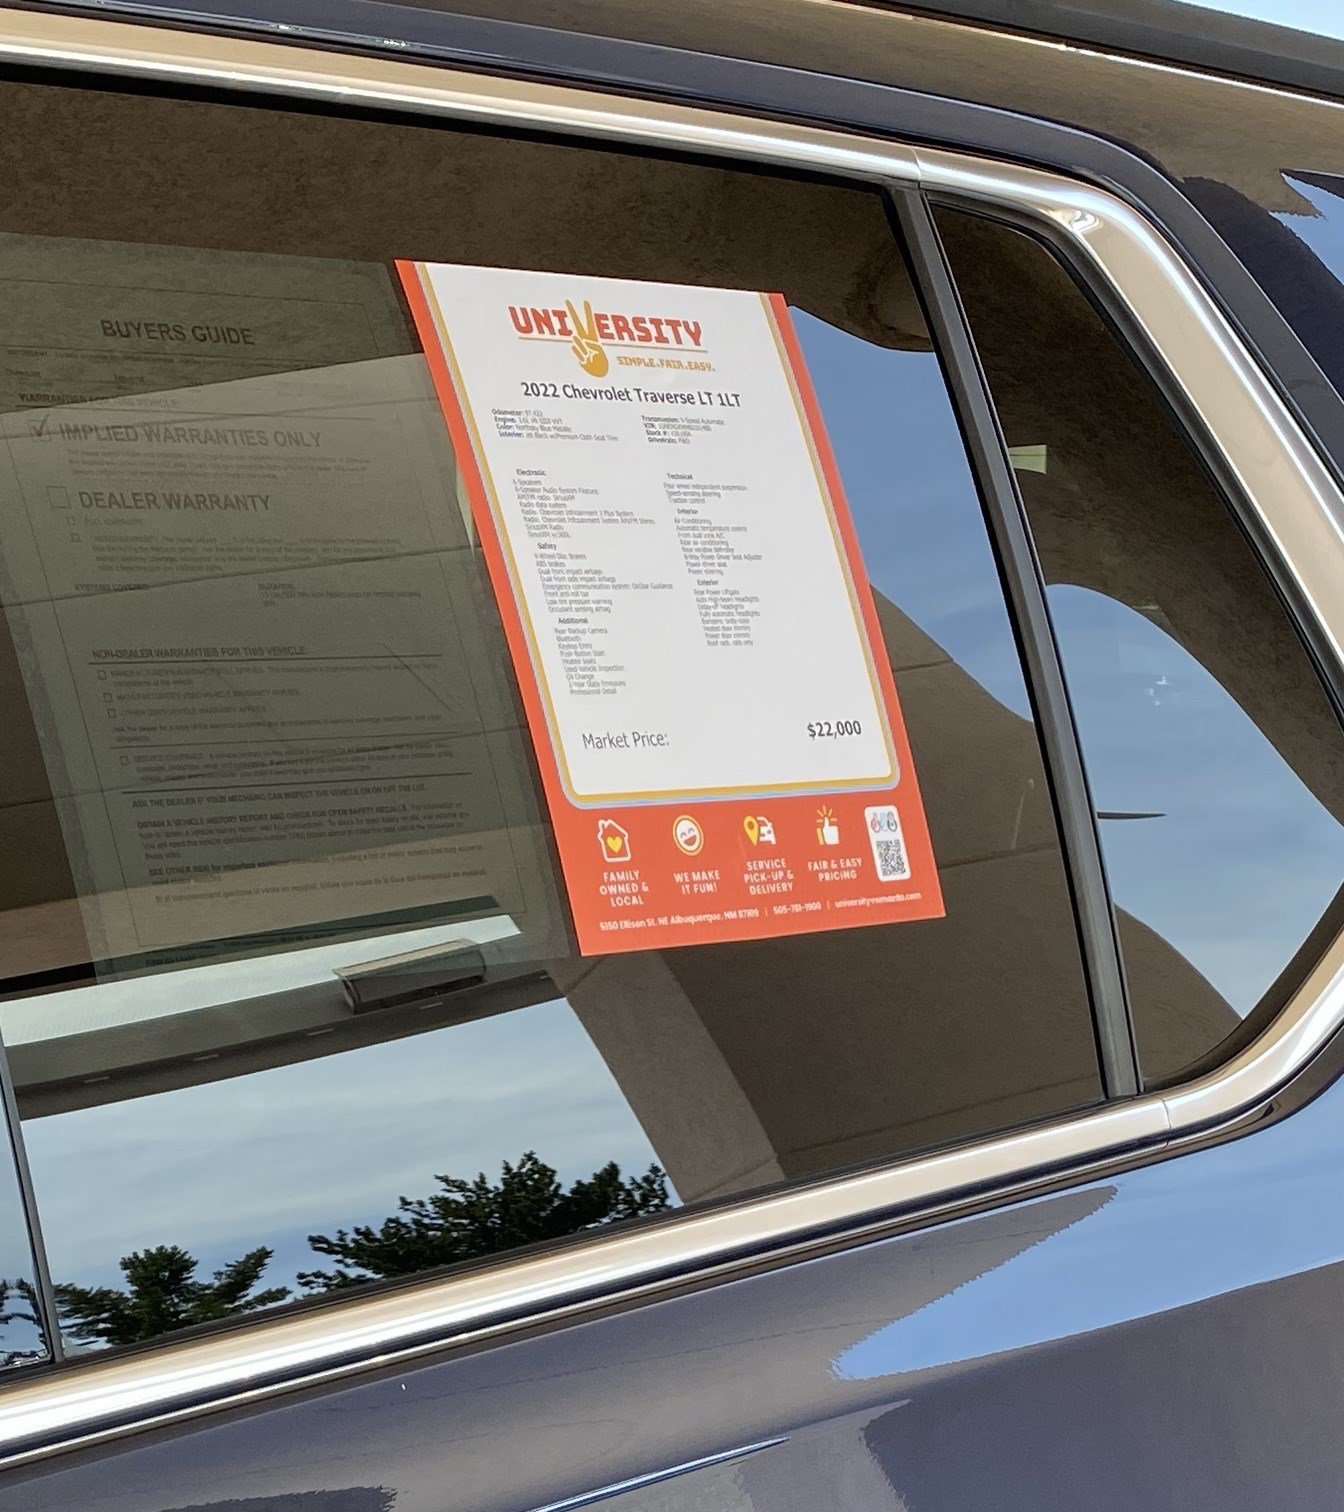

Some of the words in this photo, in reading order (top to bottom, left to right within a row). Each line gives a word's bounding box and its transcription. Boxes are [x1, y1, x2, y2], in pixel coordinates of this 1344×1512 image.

[508, 300, 702, 347] UNIVERSITY
[99, 319, 186, 342] BUYERS
[191, 325, 255, 345] GUIDE
[520, 382, 560, 399] 2022
[562, 384, 632, 402] Chevrolet
[633, 388, 696, 406] Traverse
[698, 391, 713, 406] LT
[716, 393, 742, 408] 1LT
[58, 423, 138, 442] IMPLIED
[142, 424, 269, 447] WARRANTIES
[274, 430, 321, 448] ONLY
[79, 491, 158, 510] DEALER
[161, 493, 270, 511] WARRANTY
[582, 732, 630, 750] Market
[632, 731, 670, 748] Price:
[806, 720, 862, 740] $22,000
[746, 858, 787, 871] SERVICE
[807, 860, 829, 871] FAIR
[831, 859, 838, 869] &
[840, 858, 862, 868] EASY
[603, 869, 640, 882] FAMILY
[673, 872, 690, 883] WE
[691, 869, 721, 882] MAKE
[743, 872, 786, 884] PICK-UP
[787, 870, 795, 880] &
[818, 869, 858, 882] PRICING
[599, 883, 639, 896] OWNED
[641, 882, 649, 892] &
[681, 884, 691, 895] IT
[693, 882, 717, 894] FUN!
[749, 882, 793, 896] DELIVERY
[610, 895, 645, 907] LOCAL
